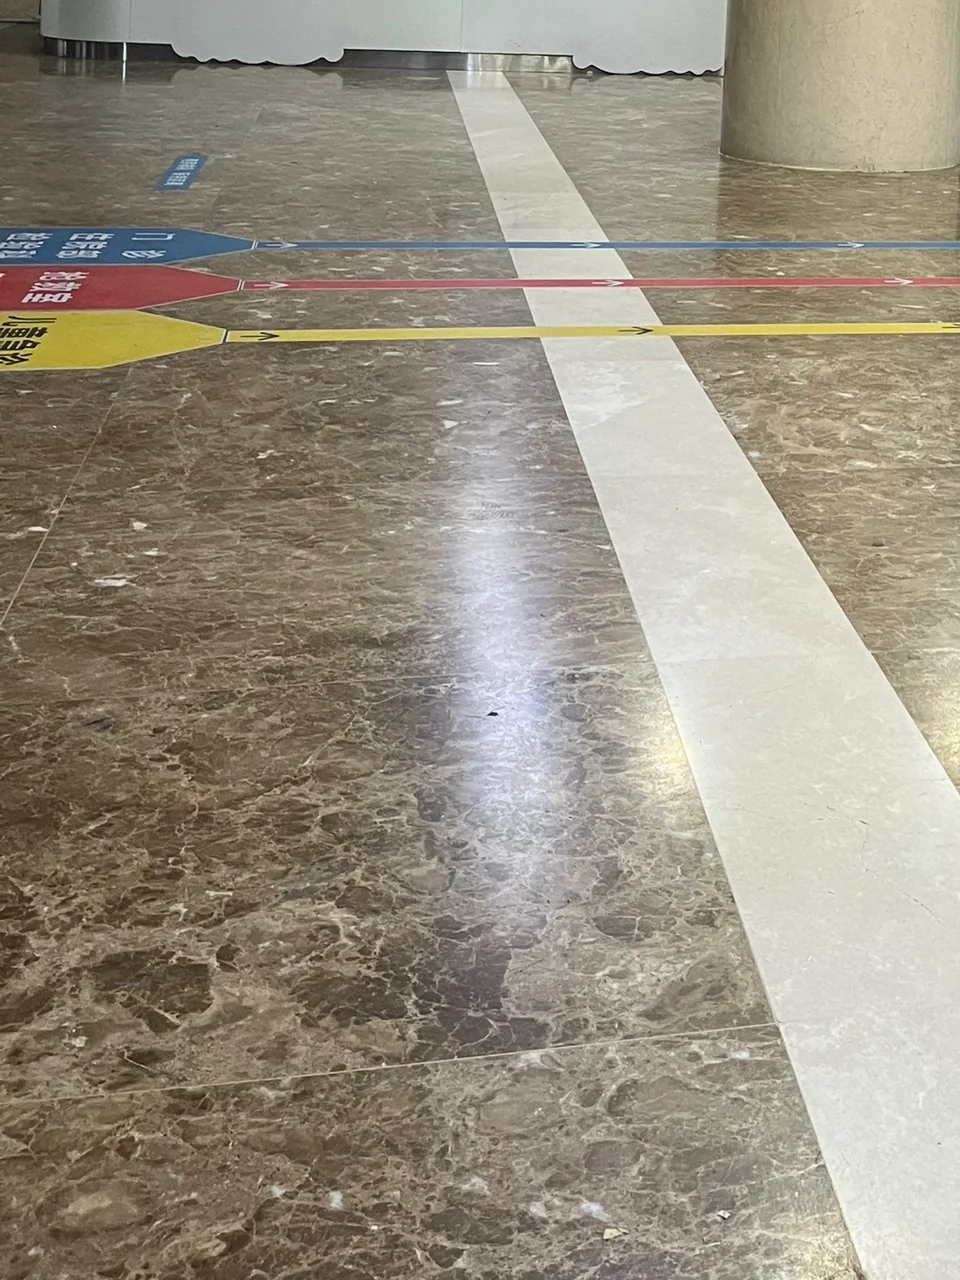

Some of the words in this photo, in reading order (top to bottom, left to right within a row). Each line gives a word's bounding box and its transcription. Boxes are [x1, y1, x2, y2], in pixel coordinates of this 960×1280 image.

[56, 232, 115, 259] 住院部
[121, 232, 176, 259] 门诊
[21, 271, 90, 303] 抢救室
